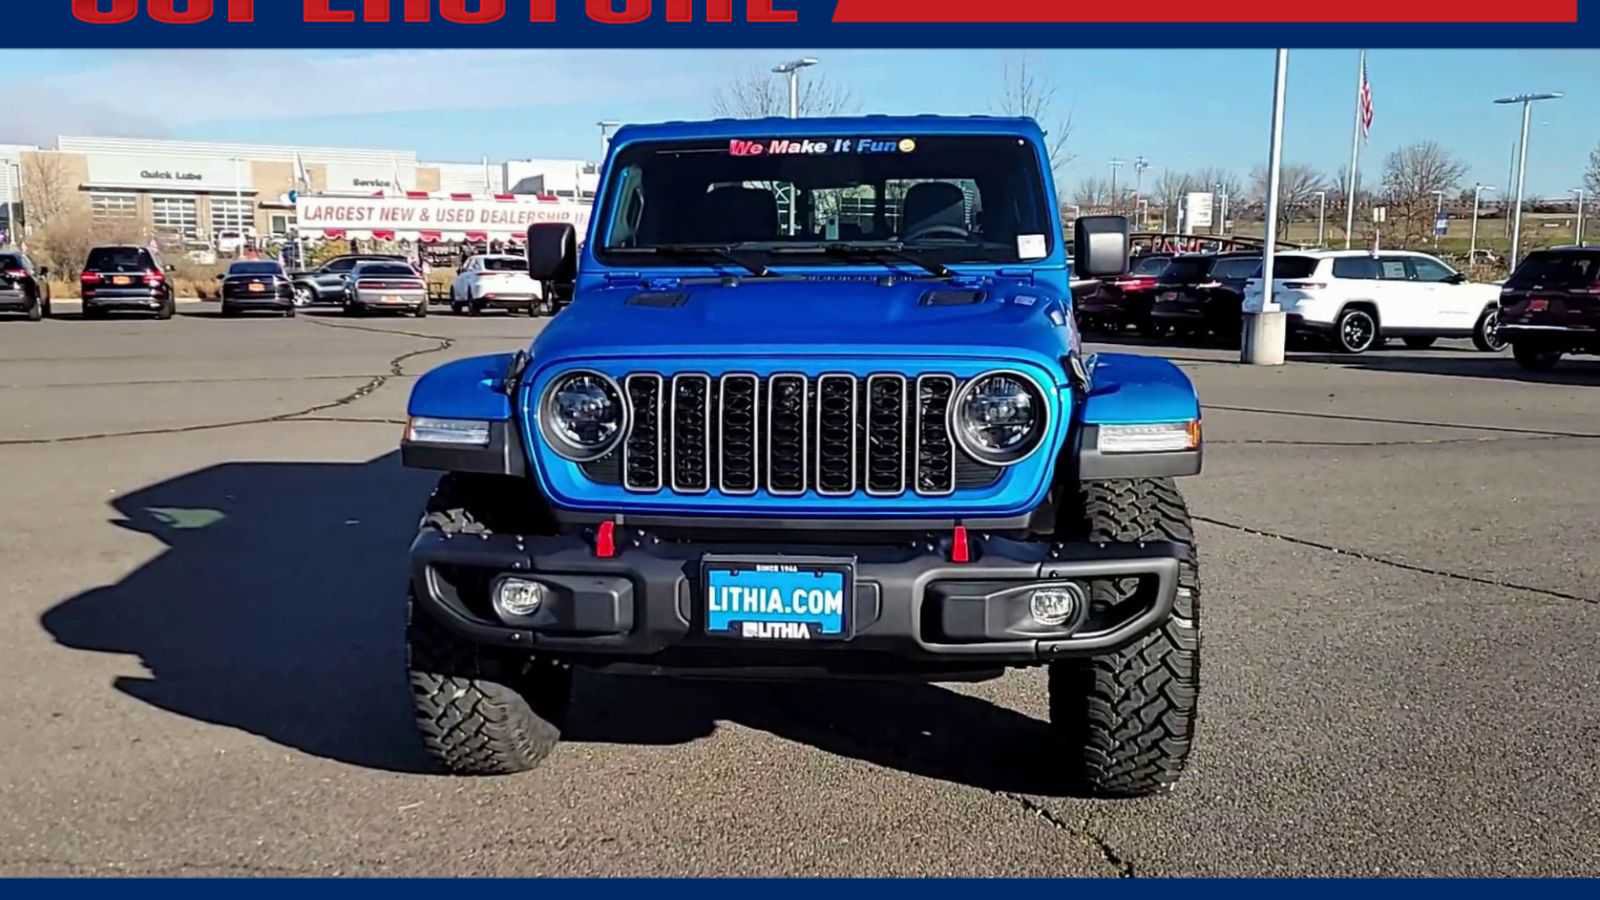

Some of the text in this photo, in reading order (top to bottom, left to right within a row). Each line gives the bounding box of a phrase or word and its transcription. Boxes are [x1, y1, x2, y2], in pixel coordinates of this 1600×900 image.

[729, 138, 897, 156] We Make It Fun
[140, 170, 202, 181] Quick Lube
[353, 178, 391, 187] Service
[304, 205, 375, 221] LARGEST
[380, 207, 416, 222] NEW
[420, 207, 430, 222] &
[436, 207, 474, 223] USED
[709, 586, 843, 615] LITHIA.COM
[758, 622, 810, 639] LITHIA
